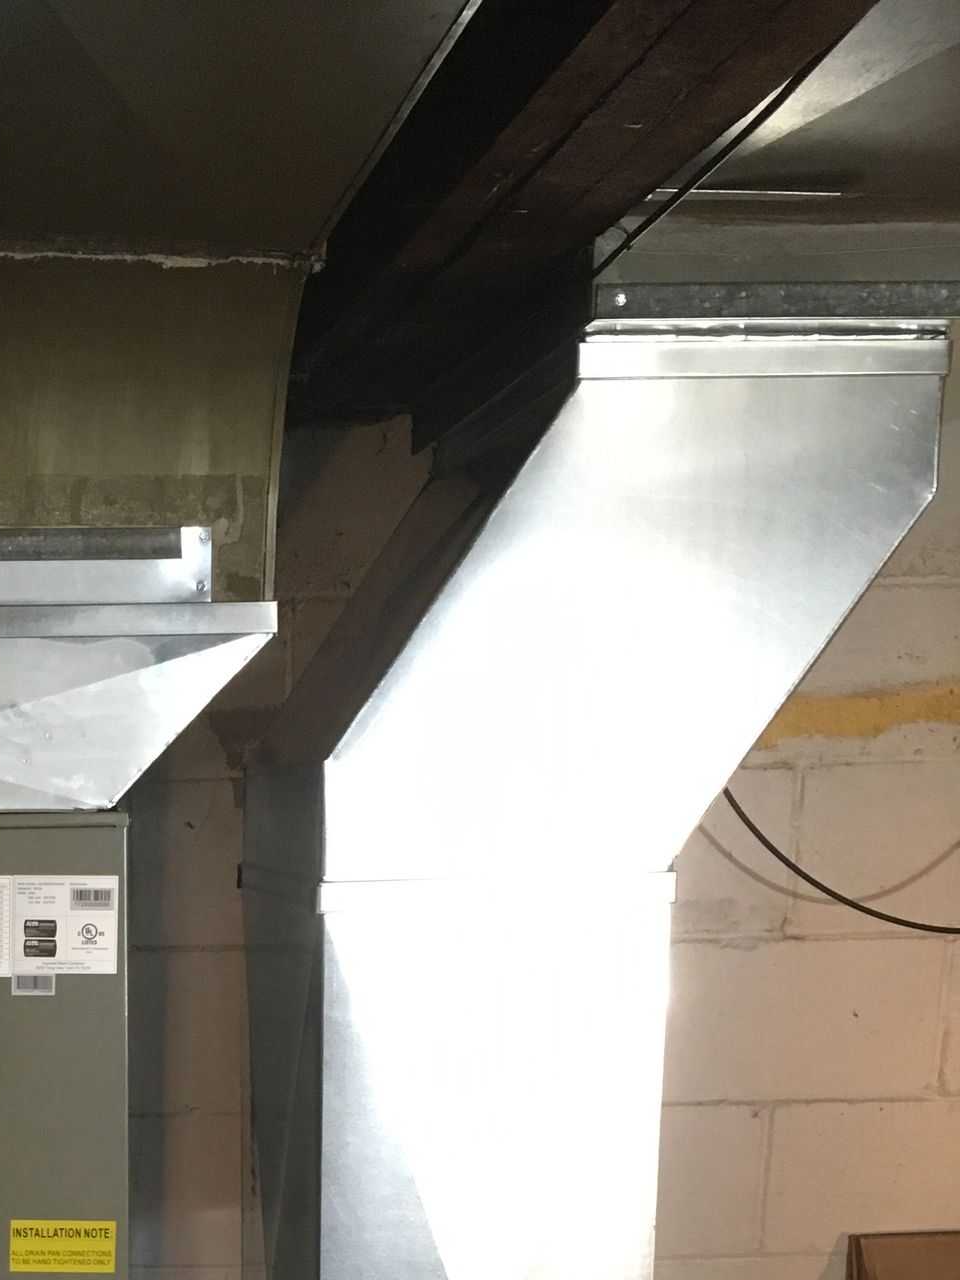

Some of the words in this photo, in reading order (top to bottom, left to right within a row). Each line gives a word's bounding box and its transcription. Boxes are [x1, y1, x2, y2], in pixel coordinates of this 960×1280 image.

[12, 1227, 81, 1239] INSTALLATION
[24, 1249, 46, 1257] DRAIN
[52, 1258, 92, 1266] TIGHTENED
[92, 1258, 111, 1266] ONLY
